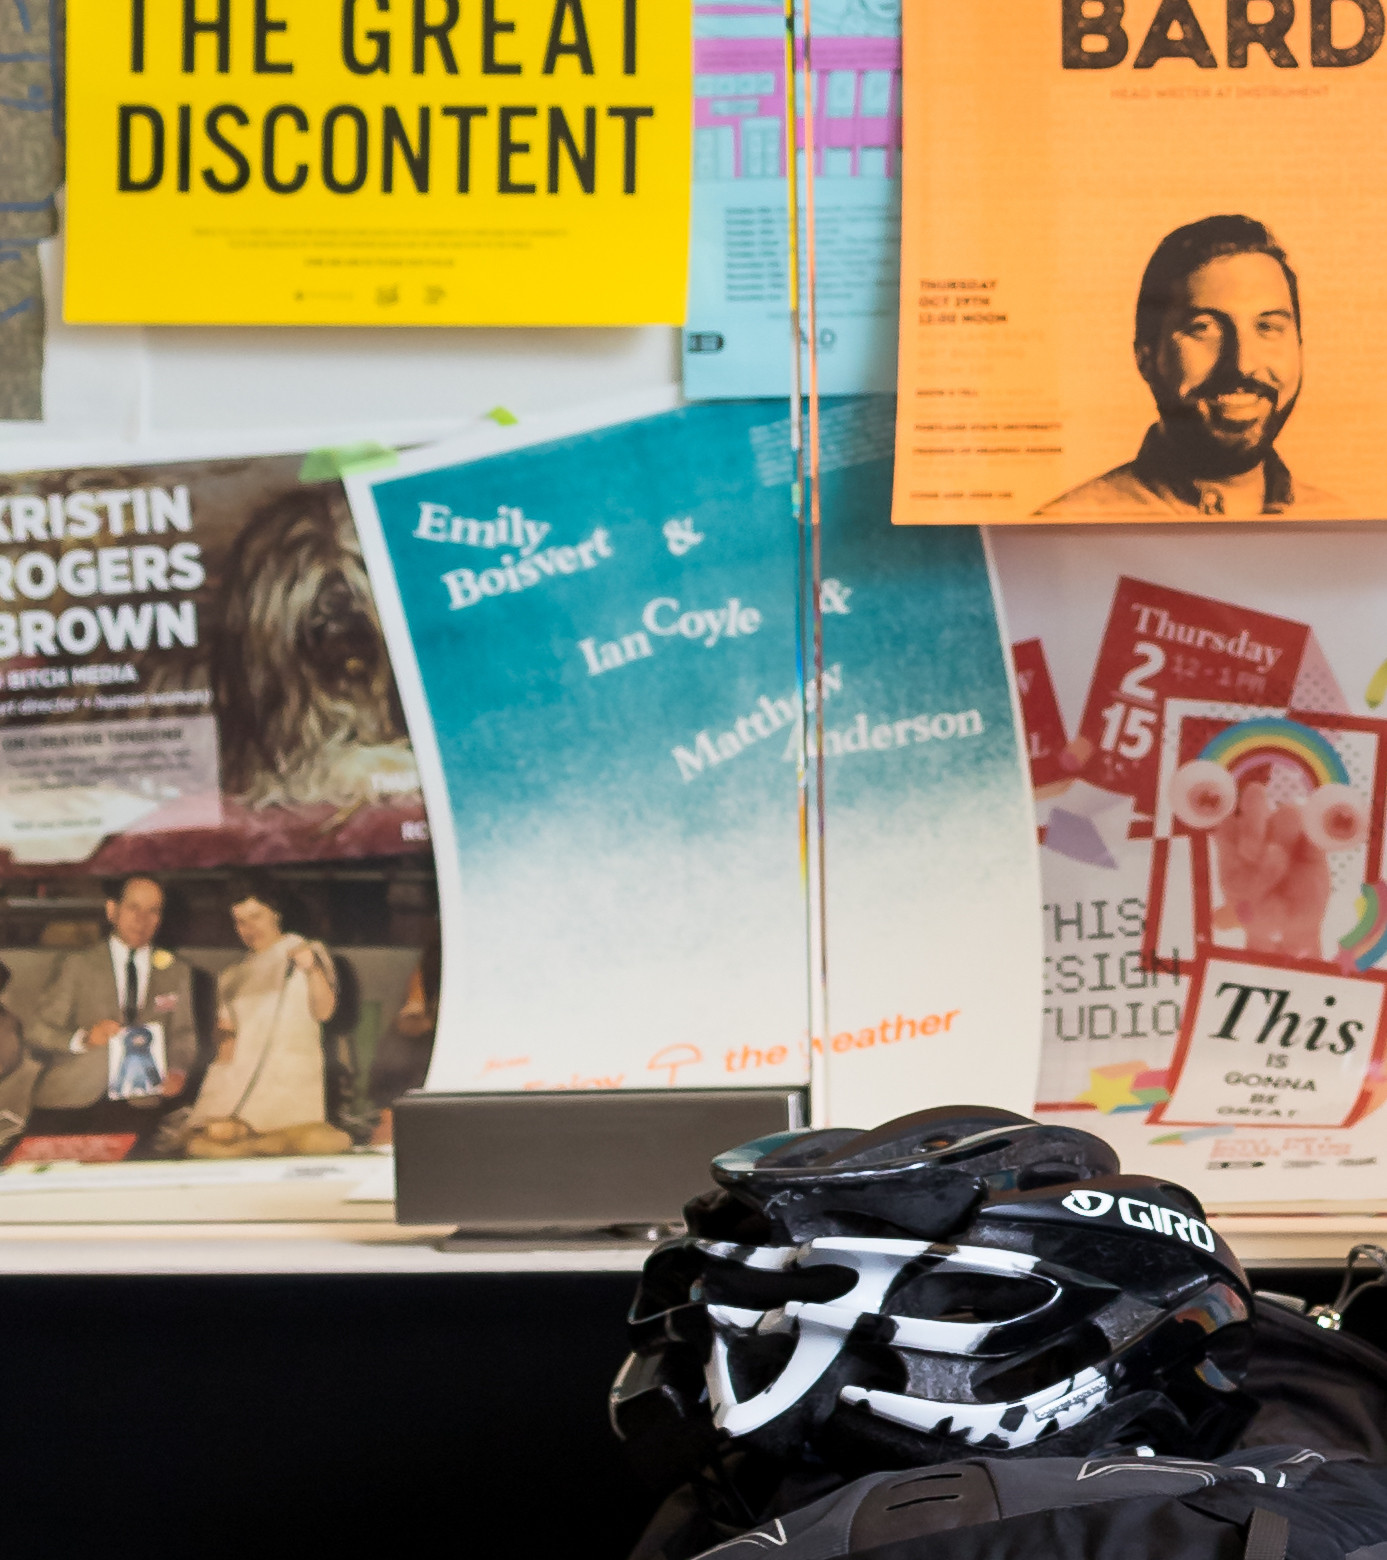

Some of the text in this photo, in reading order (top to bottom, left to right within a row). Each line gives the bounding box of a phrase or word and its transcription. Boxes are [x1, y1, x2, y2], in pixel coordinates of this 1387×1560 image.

[117, 102, 655, 195] DISCONTENT
[413, 502, 551, 554] Emily
[442, 529, 613, 612] Boisvert
[578, 596, 762, 676] Ian Coyle
[1111, 641, 1167, 702] 2
[1130, 600, 1284, 672] Thursday
[1100, 702, 1155, 760] 15
[1208, 982, 1366, 1055] This
[1118, 1198, 1216, 1253] GIRO
